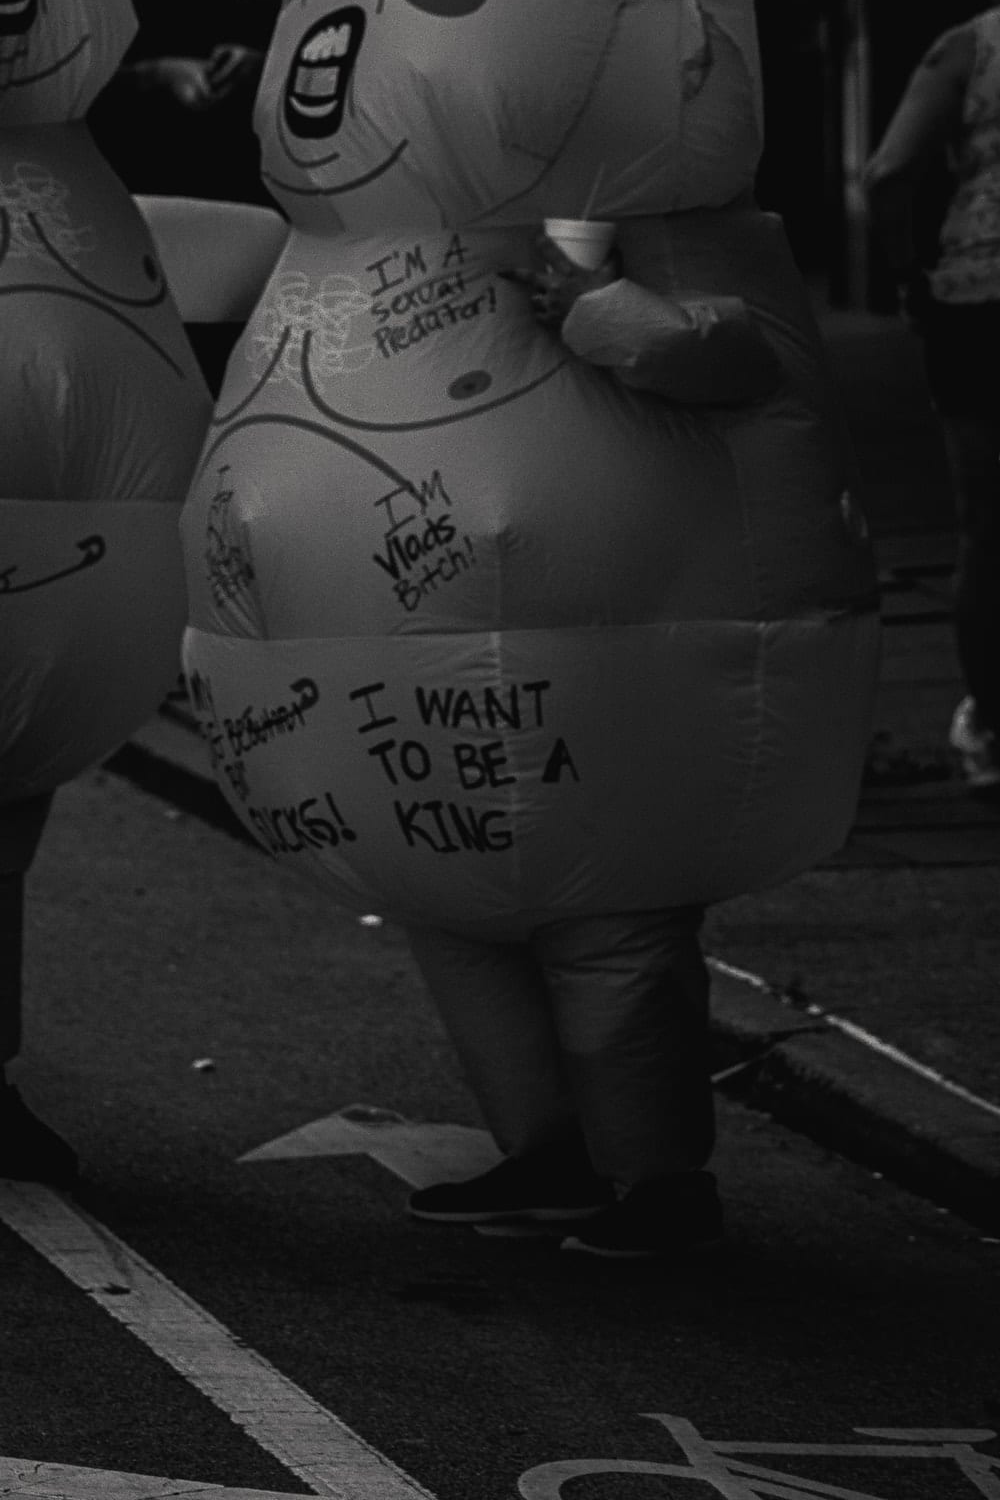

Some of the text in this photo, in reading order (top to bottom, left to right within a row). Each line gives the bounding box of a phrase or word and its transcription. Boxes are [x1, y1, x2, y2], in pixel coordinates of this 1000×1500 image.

[366, 233, 469, 296] I'M A
[373, 514, 456, 580] Vlads
[350, 682, 397, 733] I
[416, 680, 550, 729] WANT
[368, 737, 580, 790] TO BE A
[394, 801, 513, 852] KING
